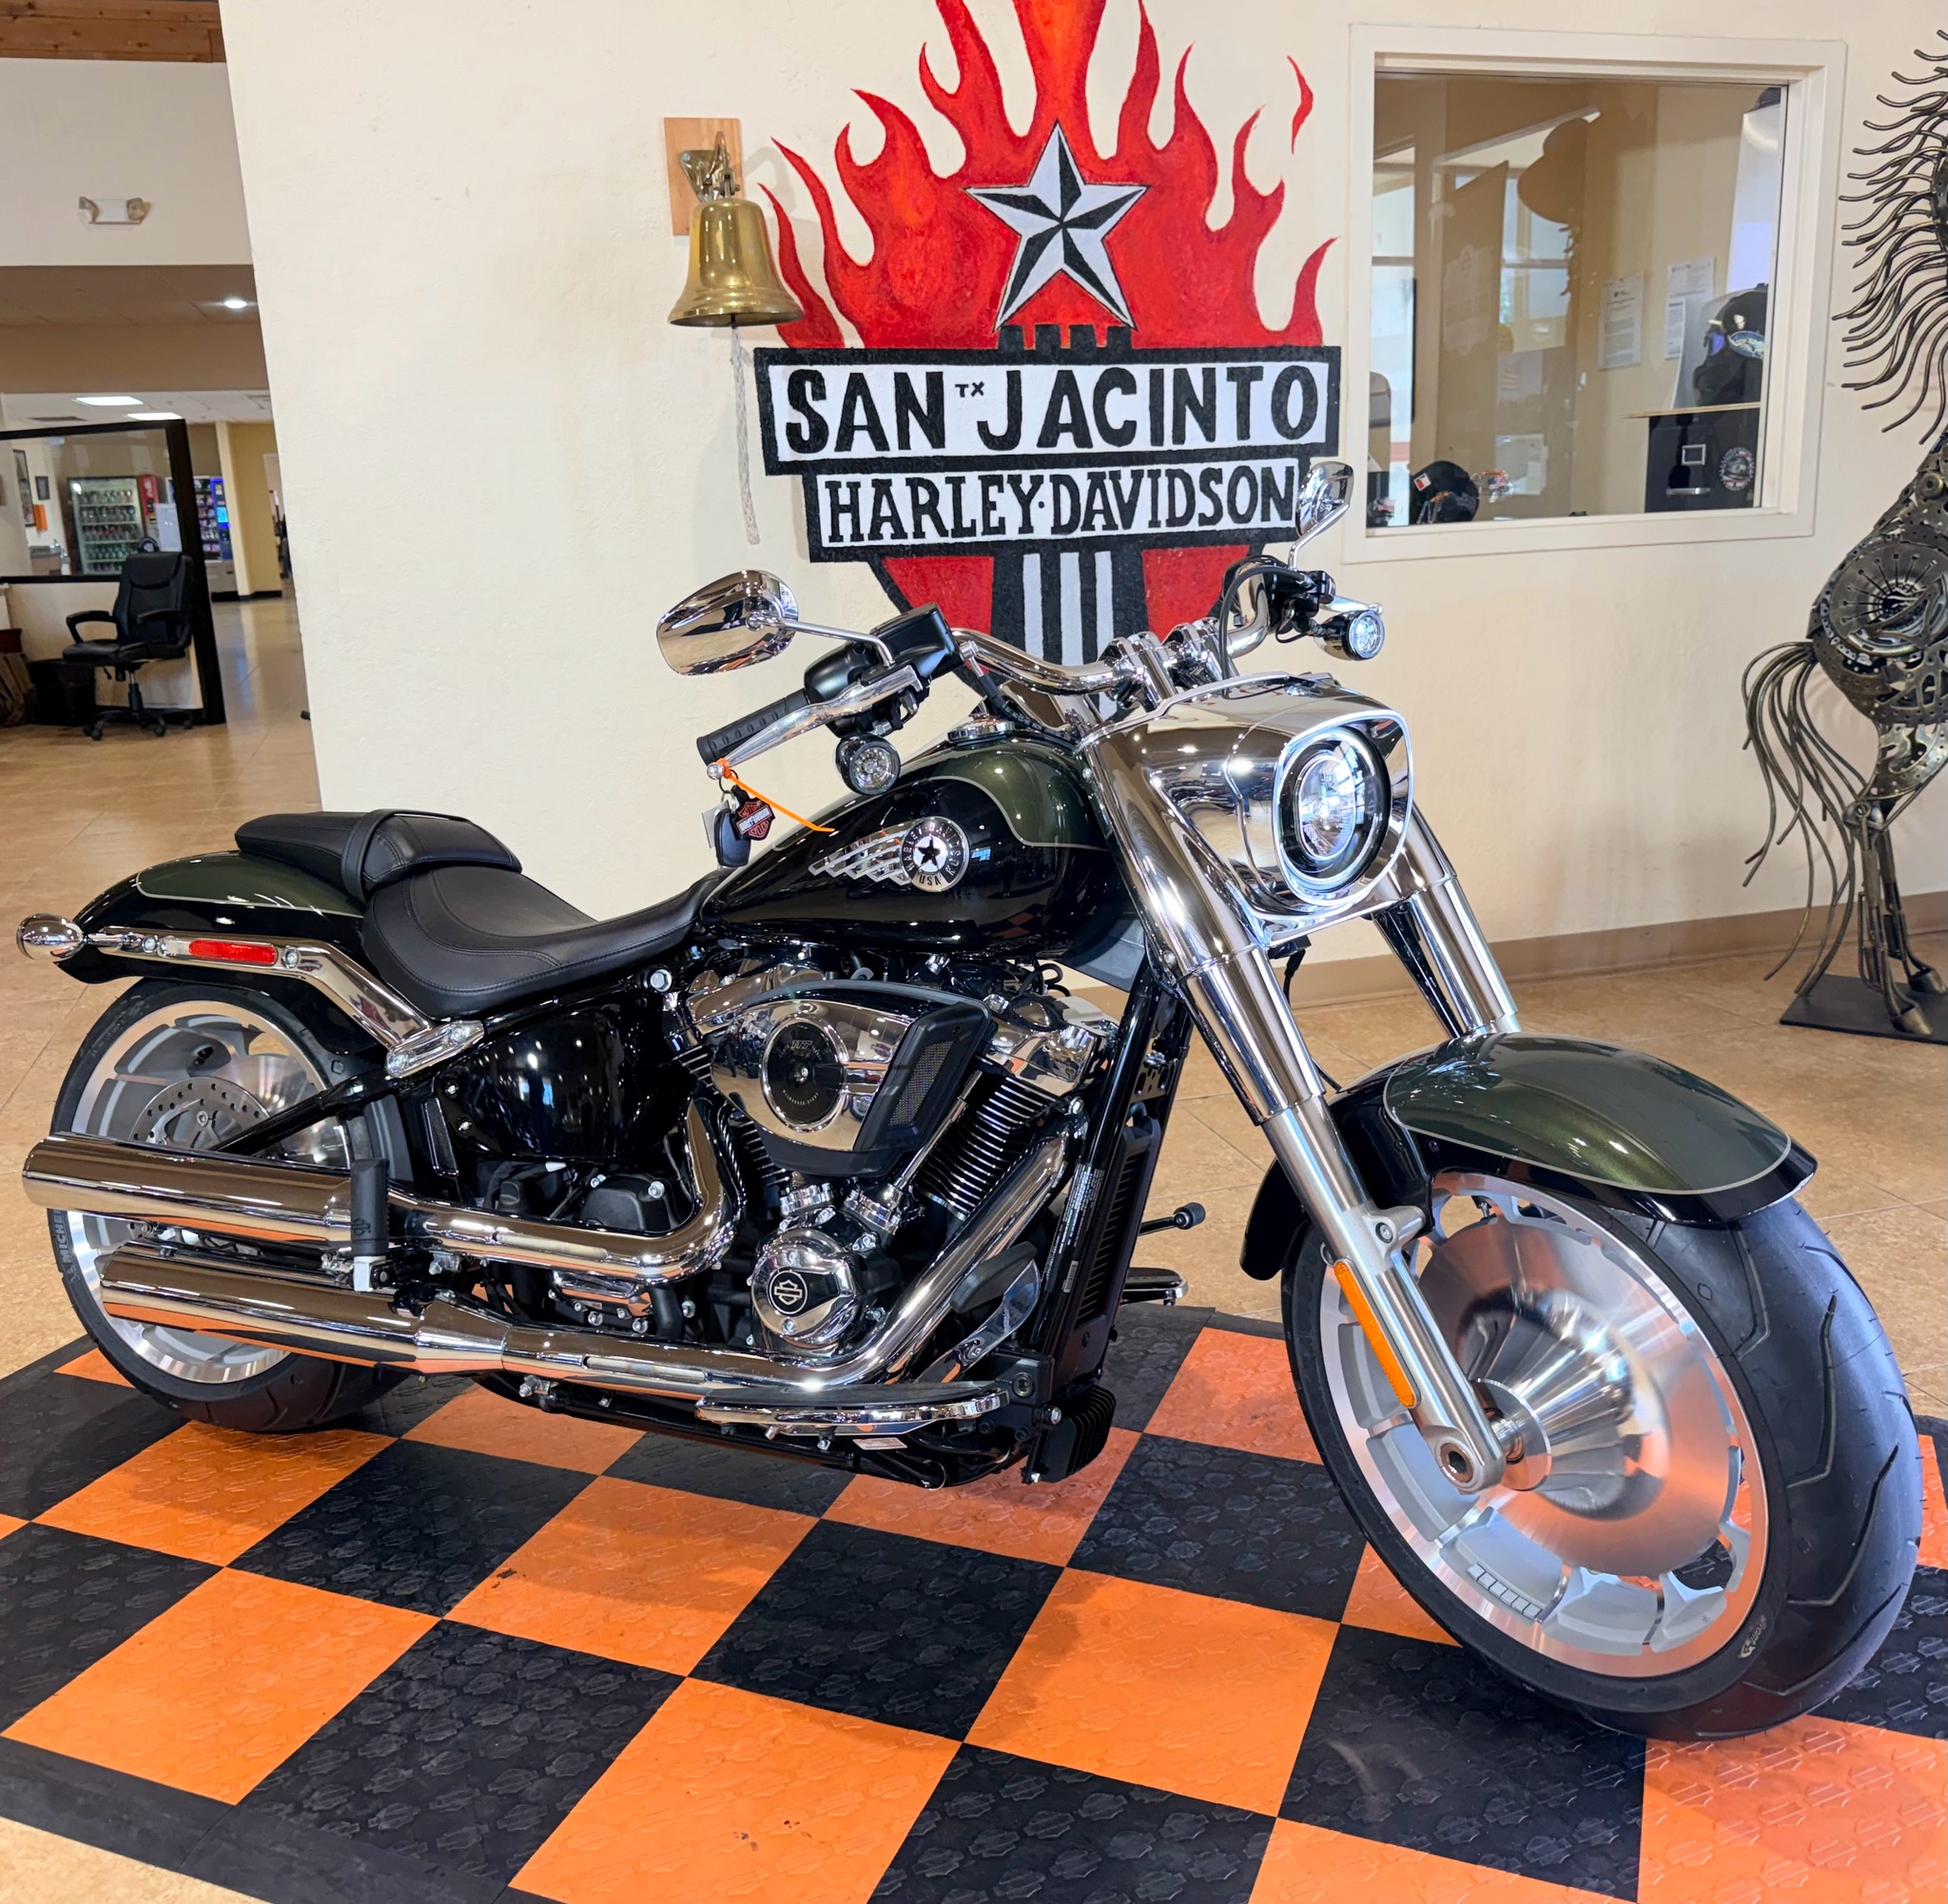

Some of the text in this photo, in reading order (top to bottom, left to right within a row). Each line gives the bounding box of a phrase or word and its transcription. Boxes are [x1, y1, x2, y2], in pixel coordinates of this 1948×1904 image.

[785, 368, 945, 454] SAN
[954, 380, 985, 398] TX
[977, 364, 1318, 451] JACINTO
[919, 874, 942, 886] USA
